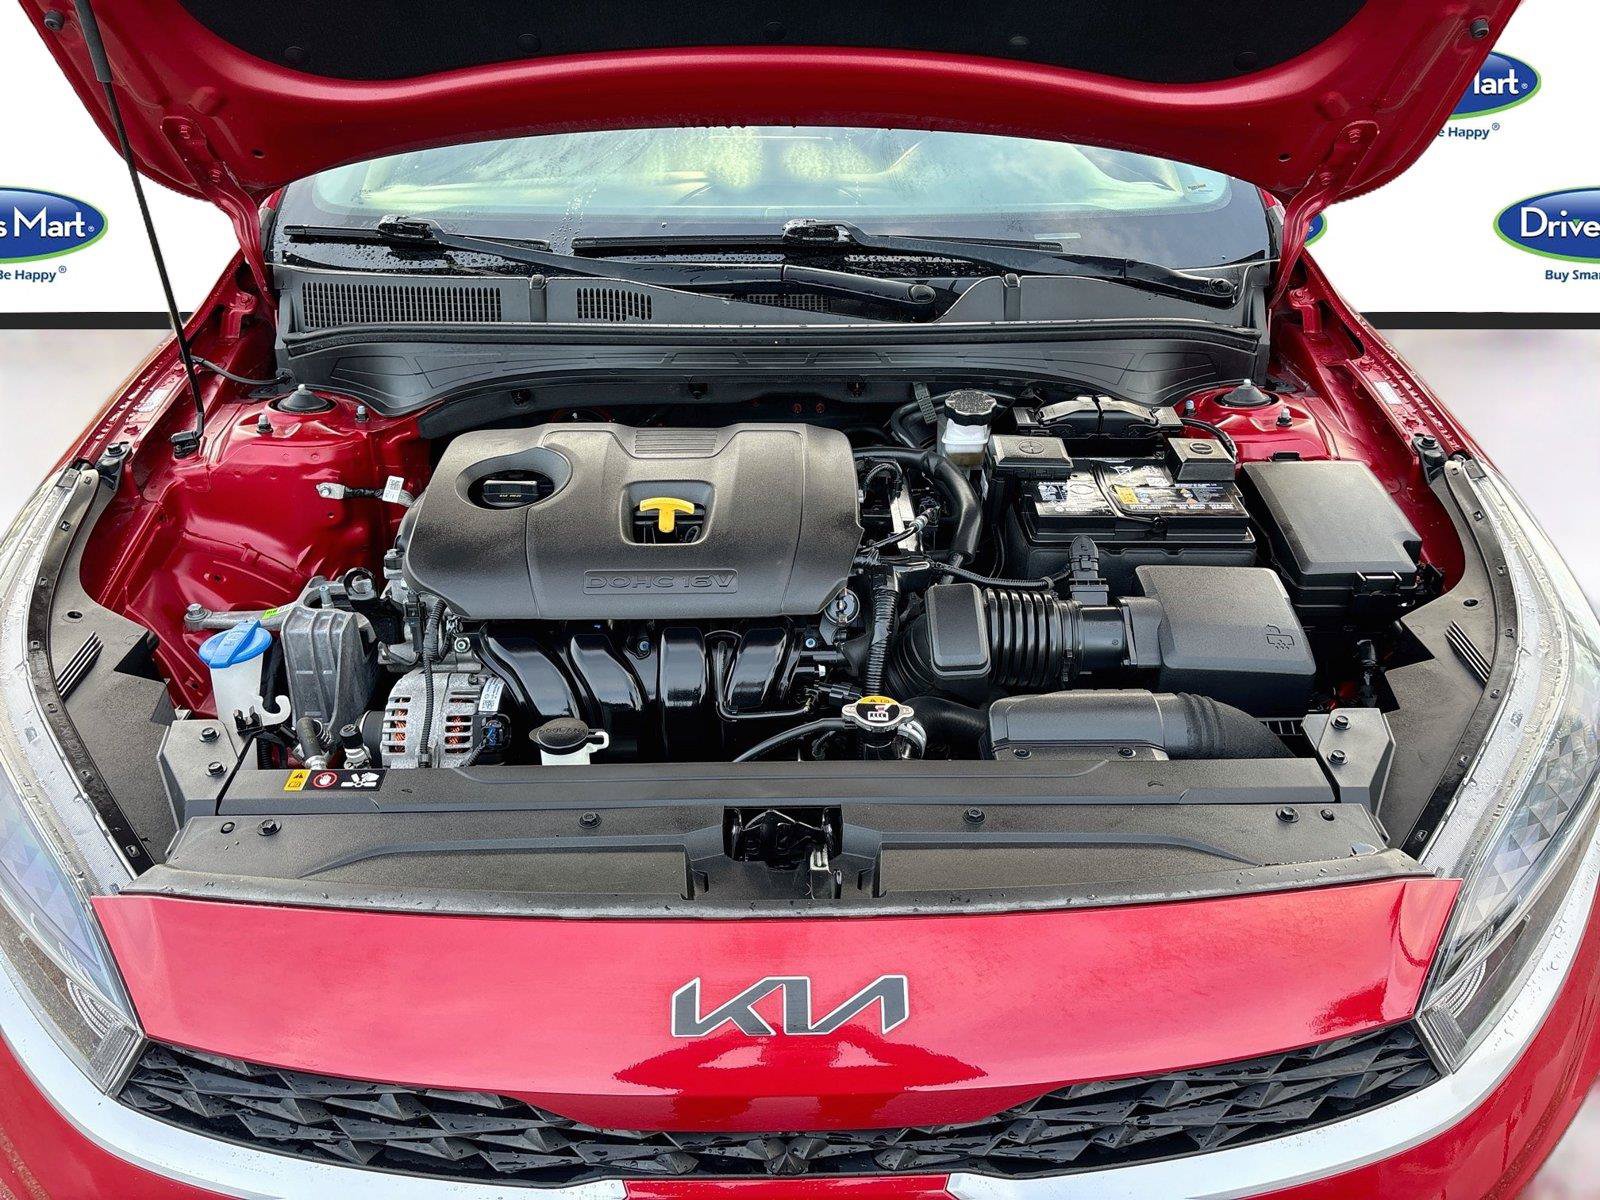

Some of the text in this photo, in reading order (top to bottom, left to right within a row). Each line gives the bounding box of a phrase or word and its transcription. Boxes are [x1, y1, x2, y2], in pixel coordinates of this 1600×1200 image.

[1473, 69, 1519, 95] art
[1448, 126, 1490, 140] Happy
[13, 206, 86, 238] Mart
[15, 269, 57, 283] Happy
[1545, 269, 1570, 283] Buy
[585, 573, 736, 589] DOHC 16V
